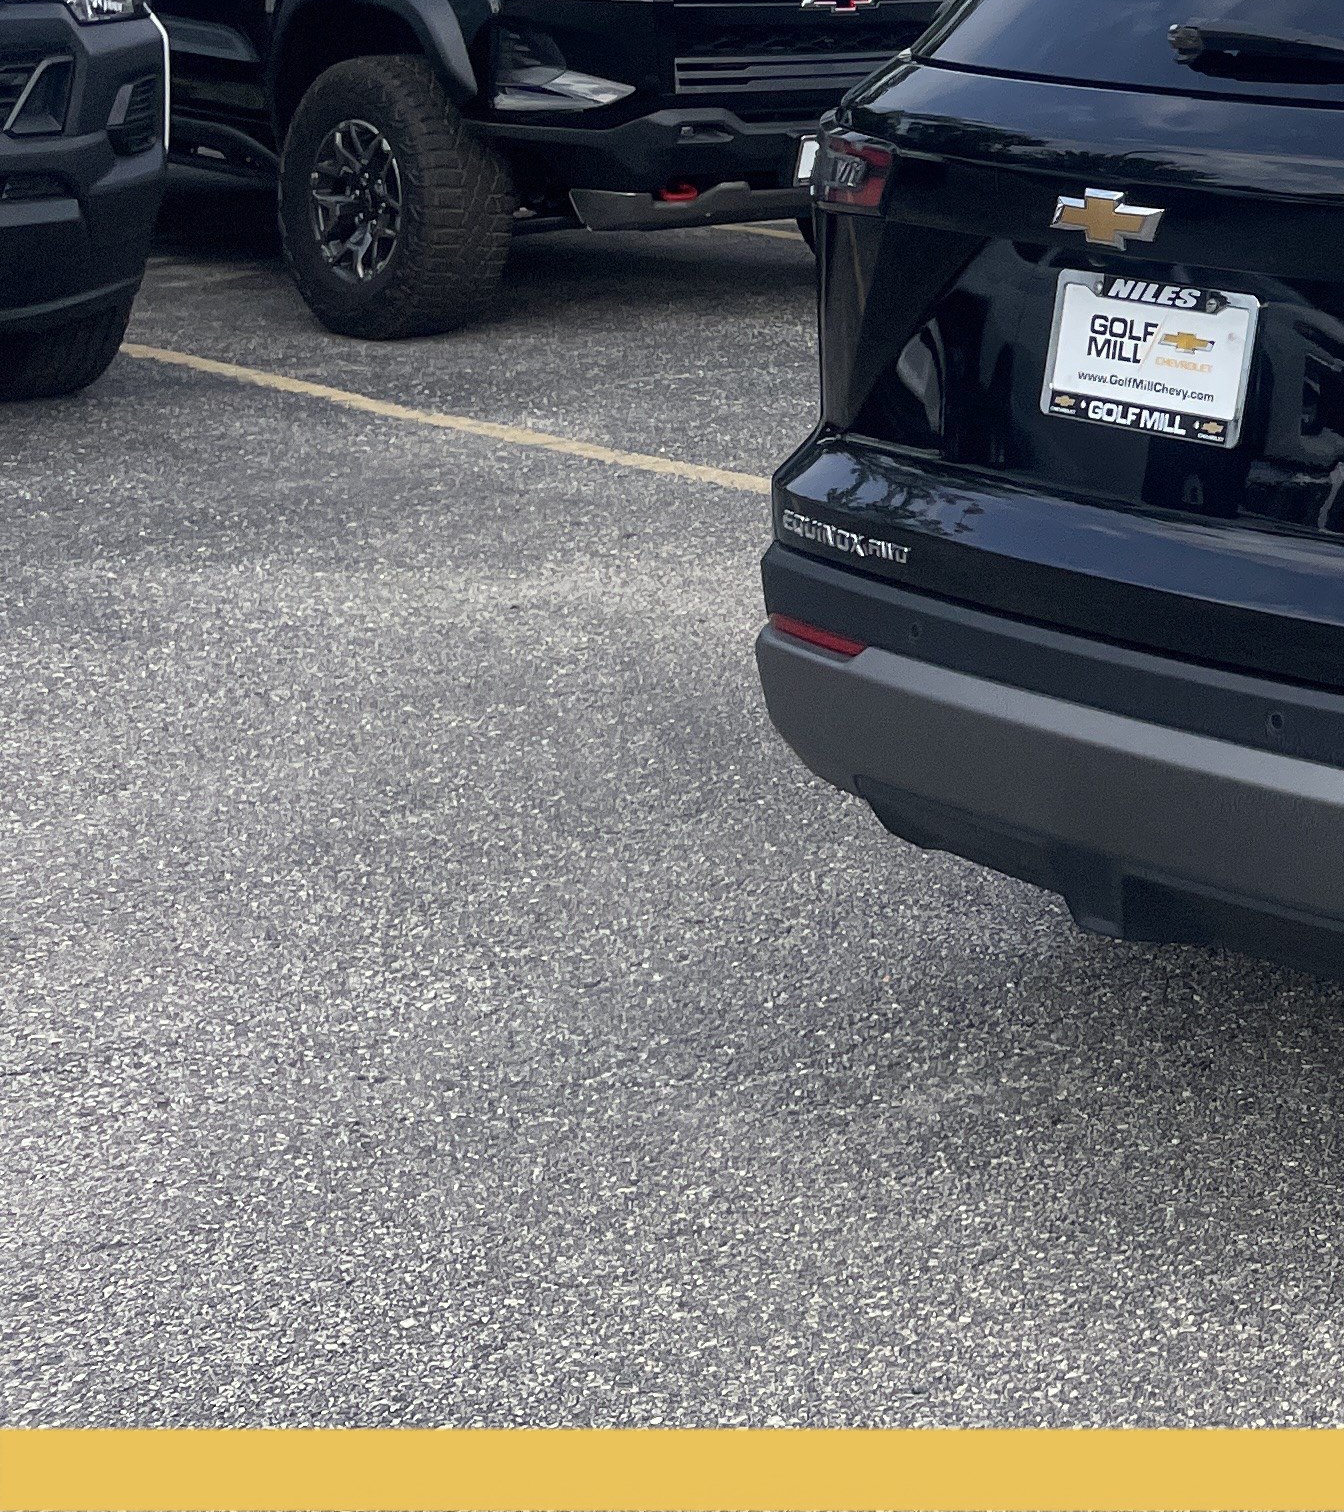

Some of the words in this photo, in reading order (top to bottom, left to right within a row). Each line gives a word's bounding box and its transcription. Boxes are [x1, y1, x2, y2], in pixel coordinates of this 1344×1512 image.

[1108, 278, 1201, 308] NILES
[1090, 314, 1159, 342] GOLF
[1087, 336, 1142, 364] MILL
[1155, 356, 1213, 374] CHEVROLET
[1078, 370, 1215, 402] www.GolfMillChevy.com
[1087, 400, 1140, 425] GOLF
[1140, 410, 1187, 436] MILL
[782, 508, 865, 558] EQUINOX
